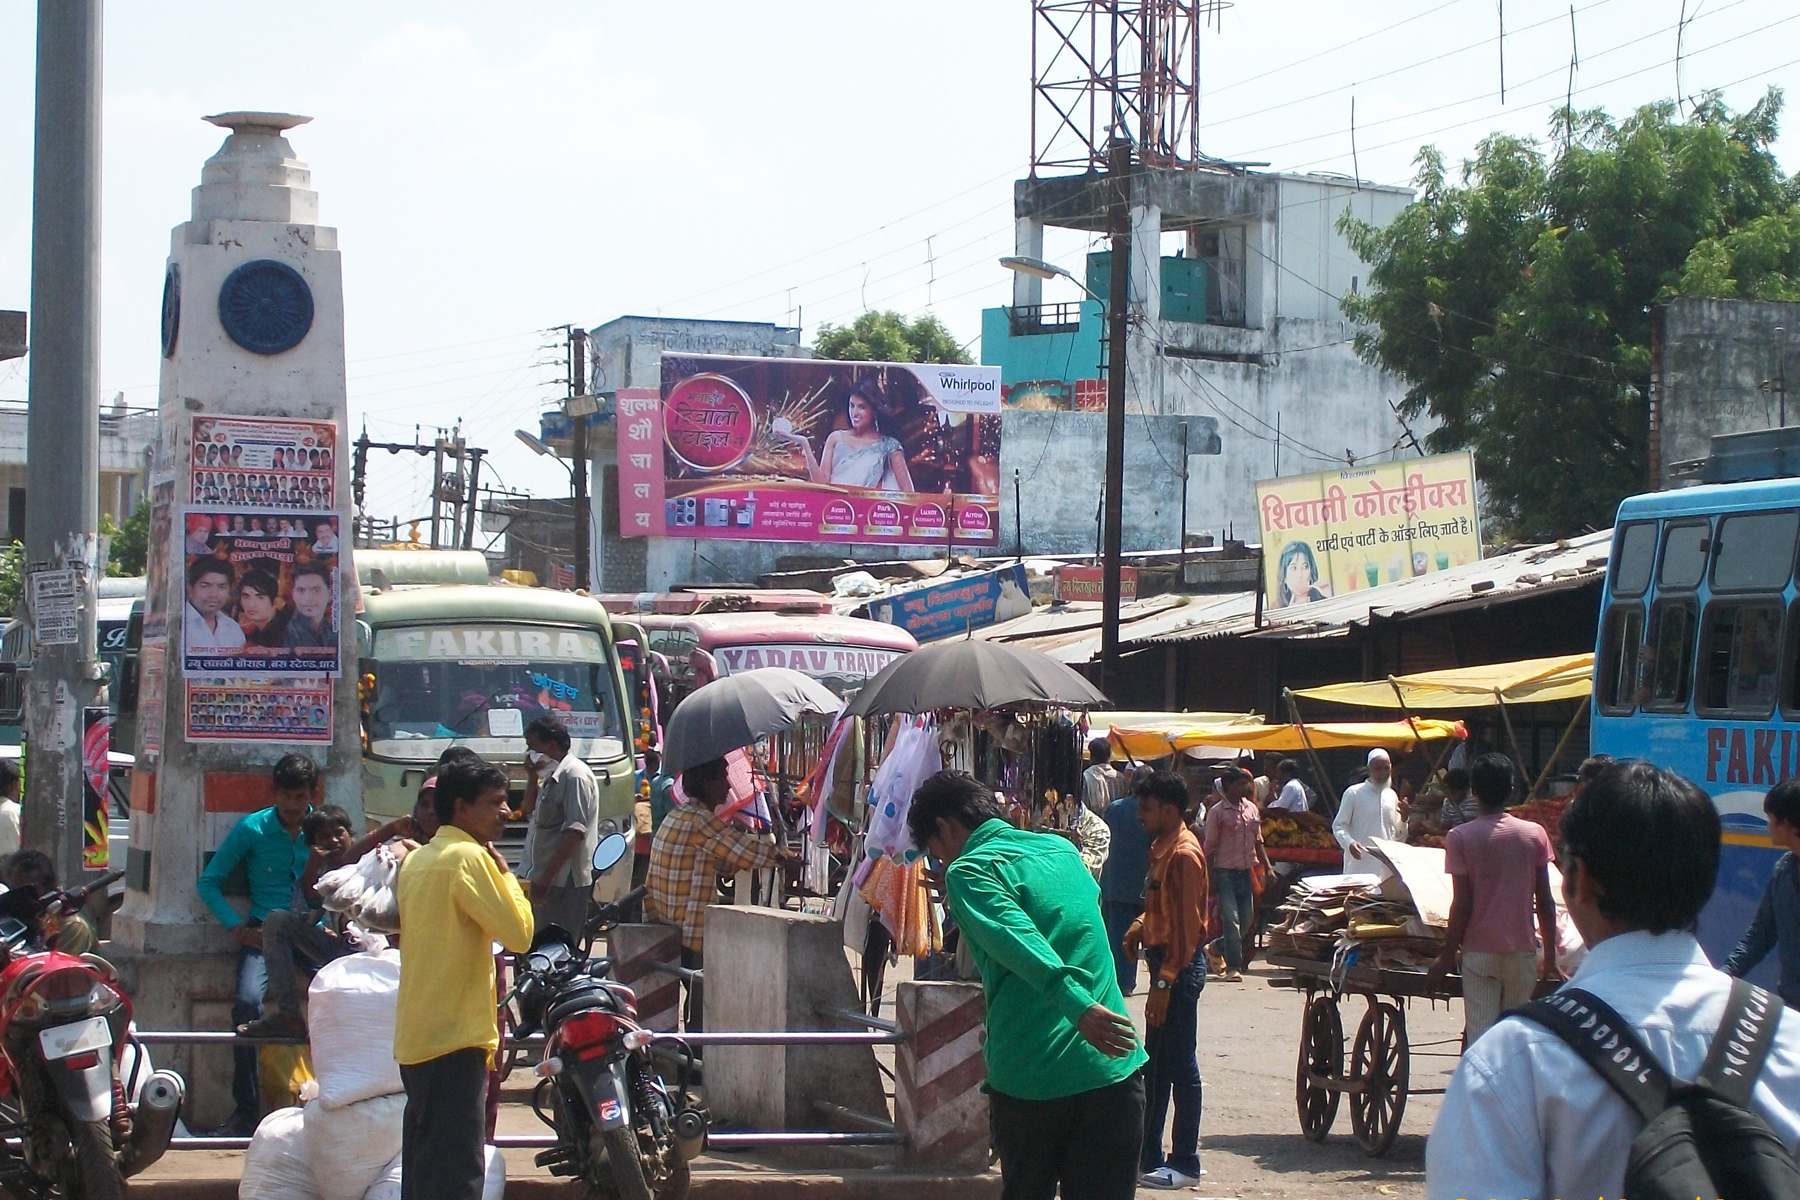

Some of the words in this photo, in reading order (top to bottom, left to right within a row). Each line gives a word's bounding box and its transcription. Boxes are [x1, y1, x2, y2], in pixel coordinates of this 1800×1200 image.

[940, 377, 995, 393] Whirlpool
[674, 401, 740, 426] दिवाली
[1261, 484, 1347, 532] शिवानी
[1316, 533, 1338, 552] शादी
[1341, 531, 1355, 553] एवं
[1356, 529, 1377, 547] पार्टी
[1379, 527, 1390, 543] के
[1419, 522, 1440, 540] लिए
[1441, 519, 1459, 535] जाते
[394, 630, 588, 658] FAKIRA
[723, 650, 828, 671] YADAV
[1707, 728, 1800, 786] FAKI
